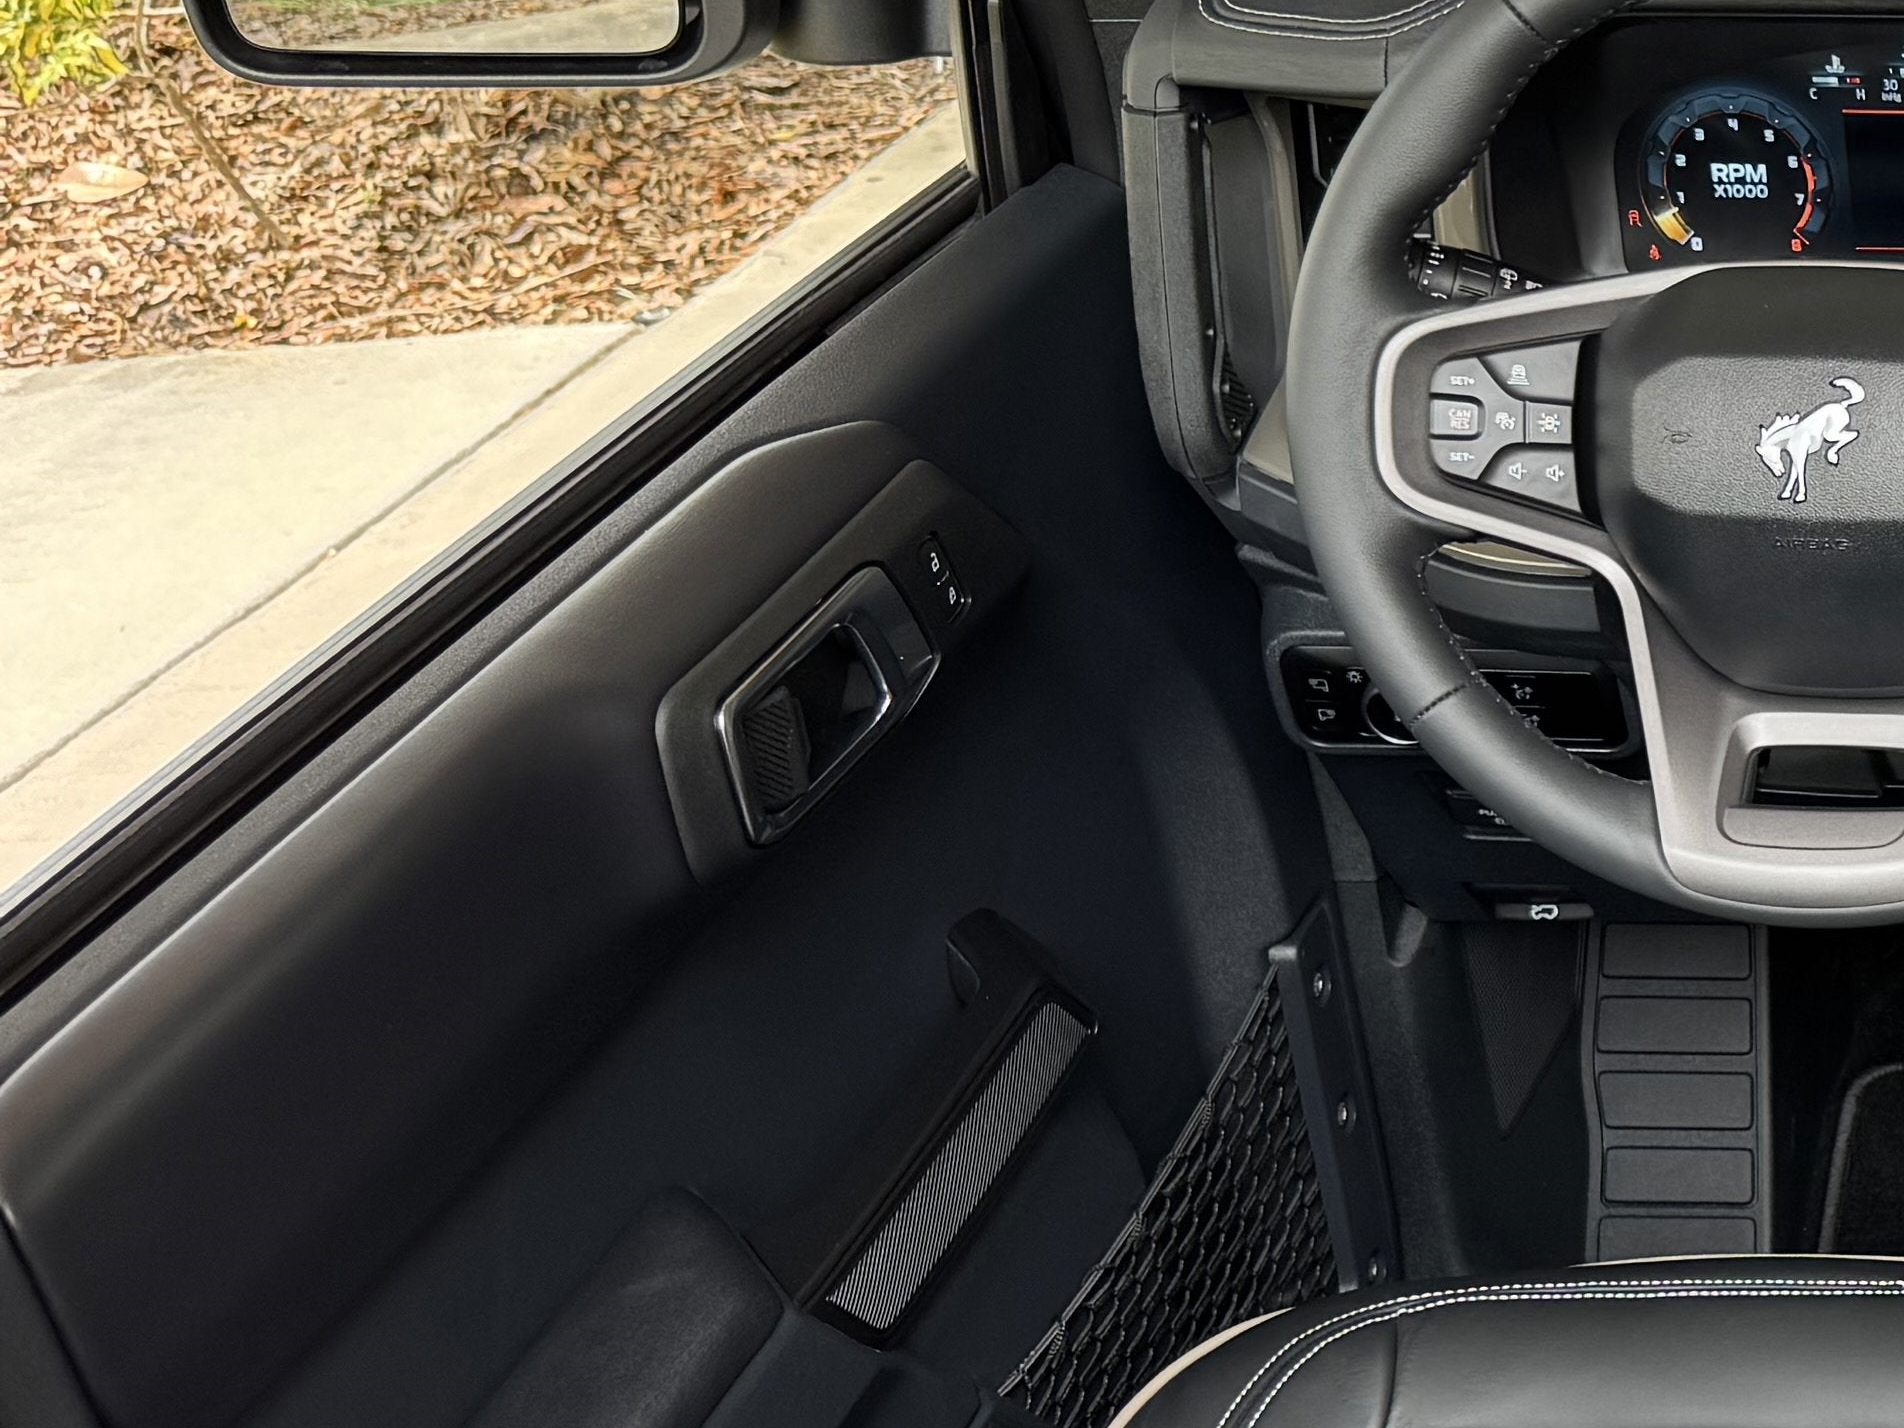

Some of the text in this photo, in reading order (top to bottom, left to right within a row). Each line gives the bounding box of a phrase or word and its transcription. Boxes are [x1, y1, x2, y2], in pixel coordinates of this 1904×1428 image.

[1883, 79, 1899, 91] 30
[1808, 88, 1818, 100] C
[1855, 89, 1866, 101] H
[1727, 118, 1739, 132] 4
[1693, 127, 1705, 141] 3
[1763, 129, 1775, 142] 5
[1674, 154, 1687, 166] 2
[1787, 155, 1799, 168] 6
[1709, 162, 1768, 184] RPM
[1675, 191, 1685, 204] 1
[1713, 184, 1769, 199] X1000
[1794, 193, 1804, 206] 7
[1690, 237, 1704, 252] 0
[1791, 238, 1802, 252] 8
[1450, 376, 1475, 386] SET+
[1448, 408, 1471, 418] CAN
[1450, 419, 1470, 430] RES
[1774, 536, 1850, 551] AIRBAG
